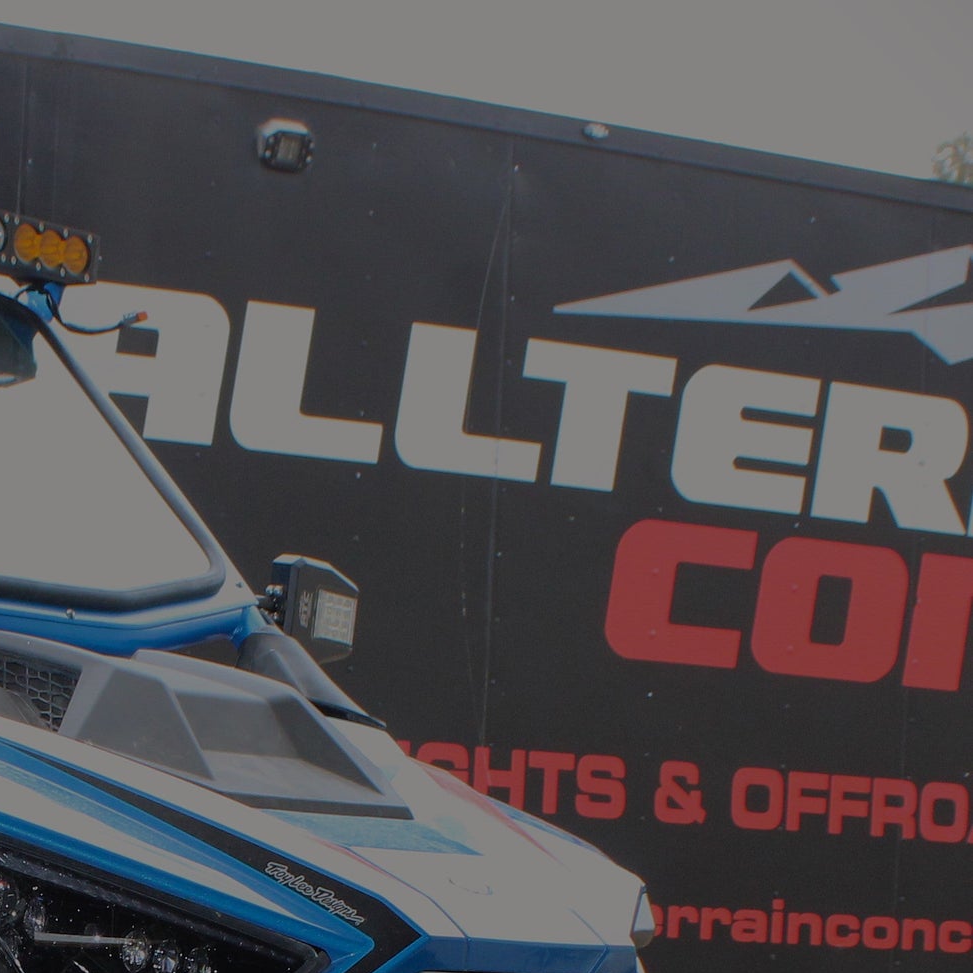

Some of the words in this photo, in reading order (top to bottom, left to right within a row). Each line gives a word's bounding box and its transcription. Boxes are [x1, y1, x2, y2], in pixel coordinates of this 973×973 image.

[57, 279, 973, 538] ALLTER
[654, 759, 707, 825] &
[730, 766, 973, 844] OFFRO
